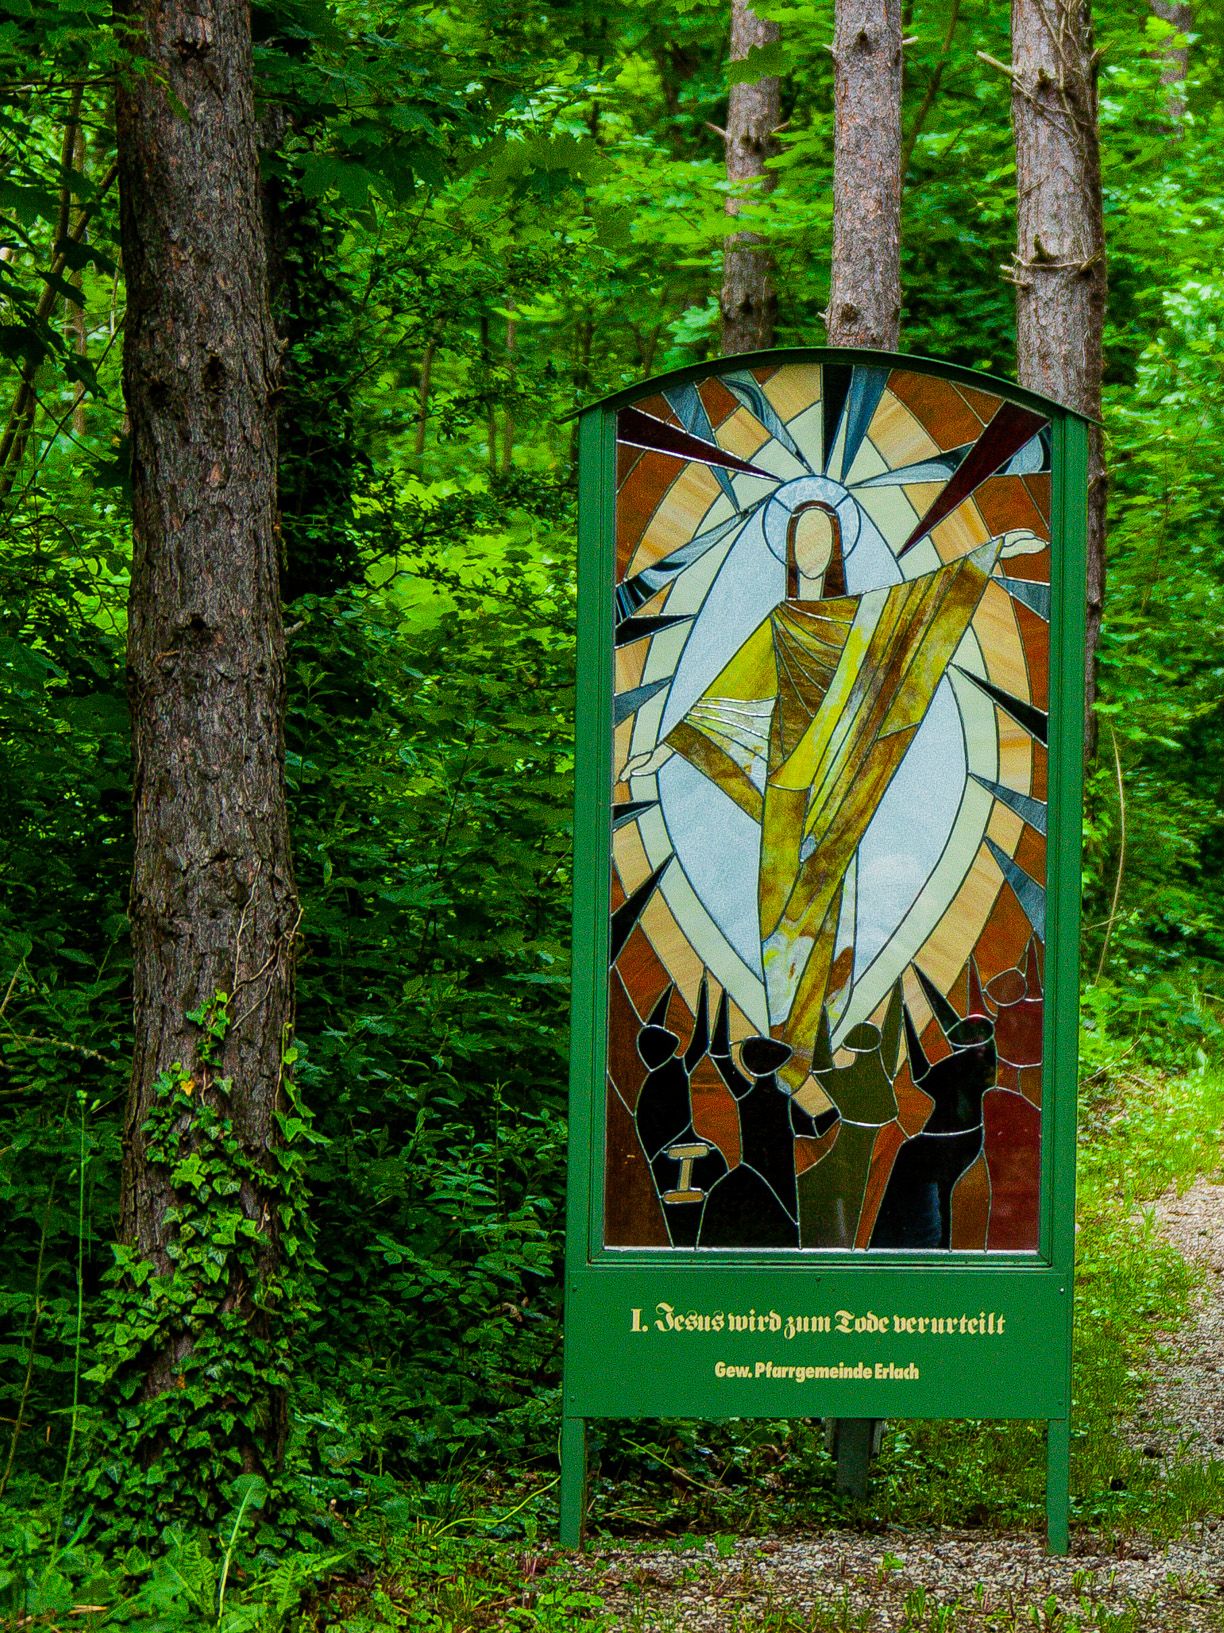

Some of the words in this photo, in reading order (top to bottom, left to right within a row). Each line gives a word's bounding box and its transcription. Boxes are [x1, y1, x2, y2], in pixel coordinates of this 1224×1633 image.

[630, 1307, 649, 1333] I.
[655, 1302, 725, 1333] Jesus
[727, 1308, 782, 1333] wird
[783, 1314, 831, 1340] zum
[834, 1309, 889, 1334] Tode
[892, 1311, 1006, 1336] verurteilt
[714, 1361, 753, 1379] Gew.
[754, 1361, 873, 1384] Pfarrgemeinde
[874, 1362, 920, 1380] Erlach
